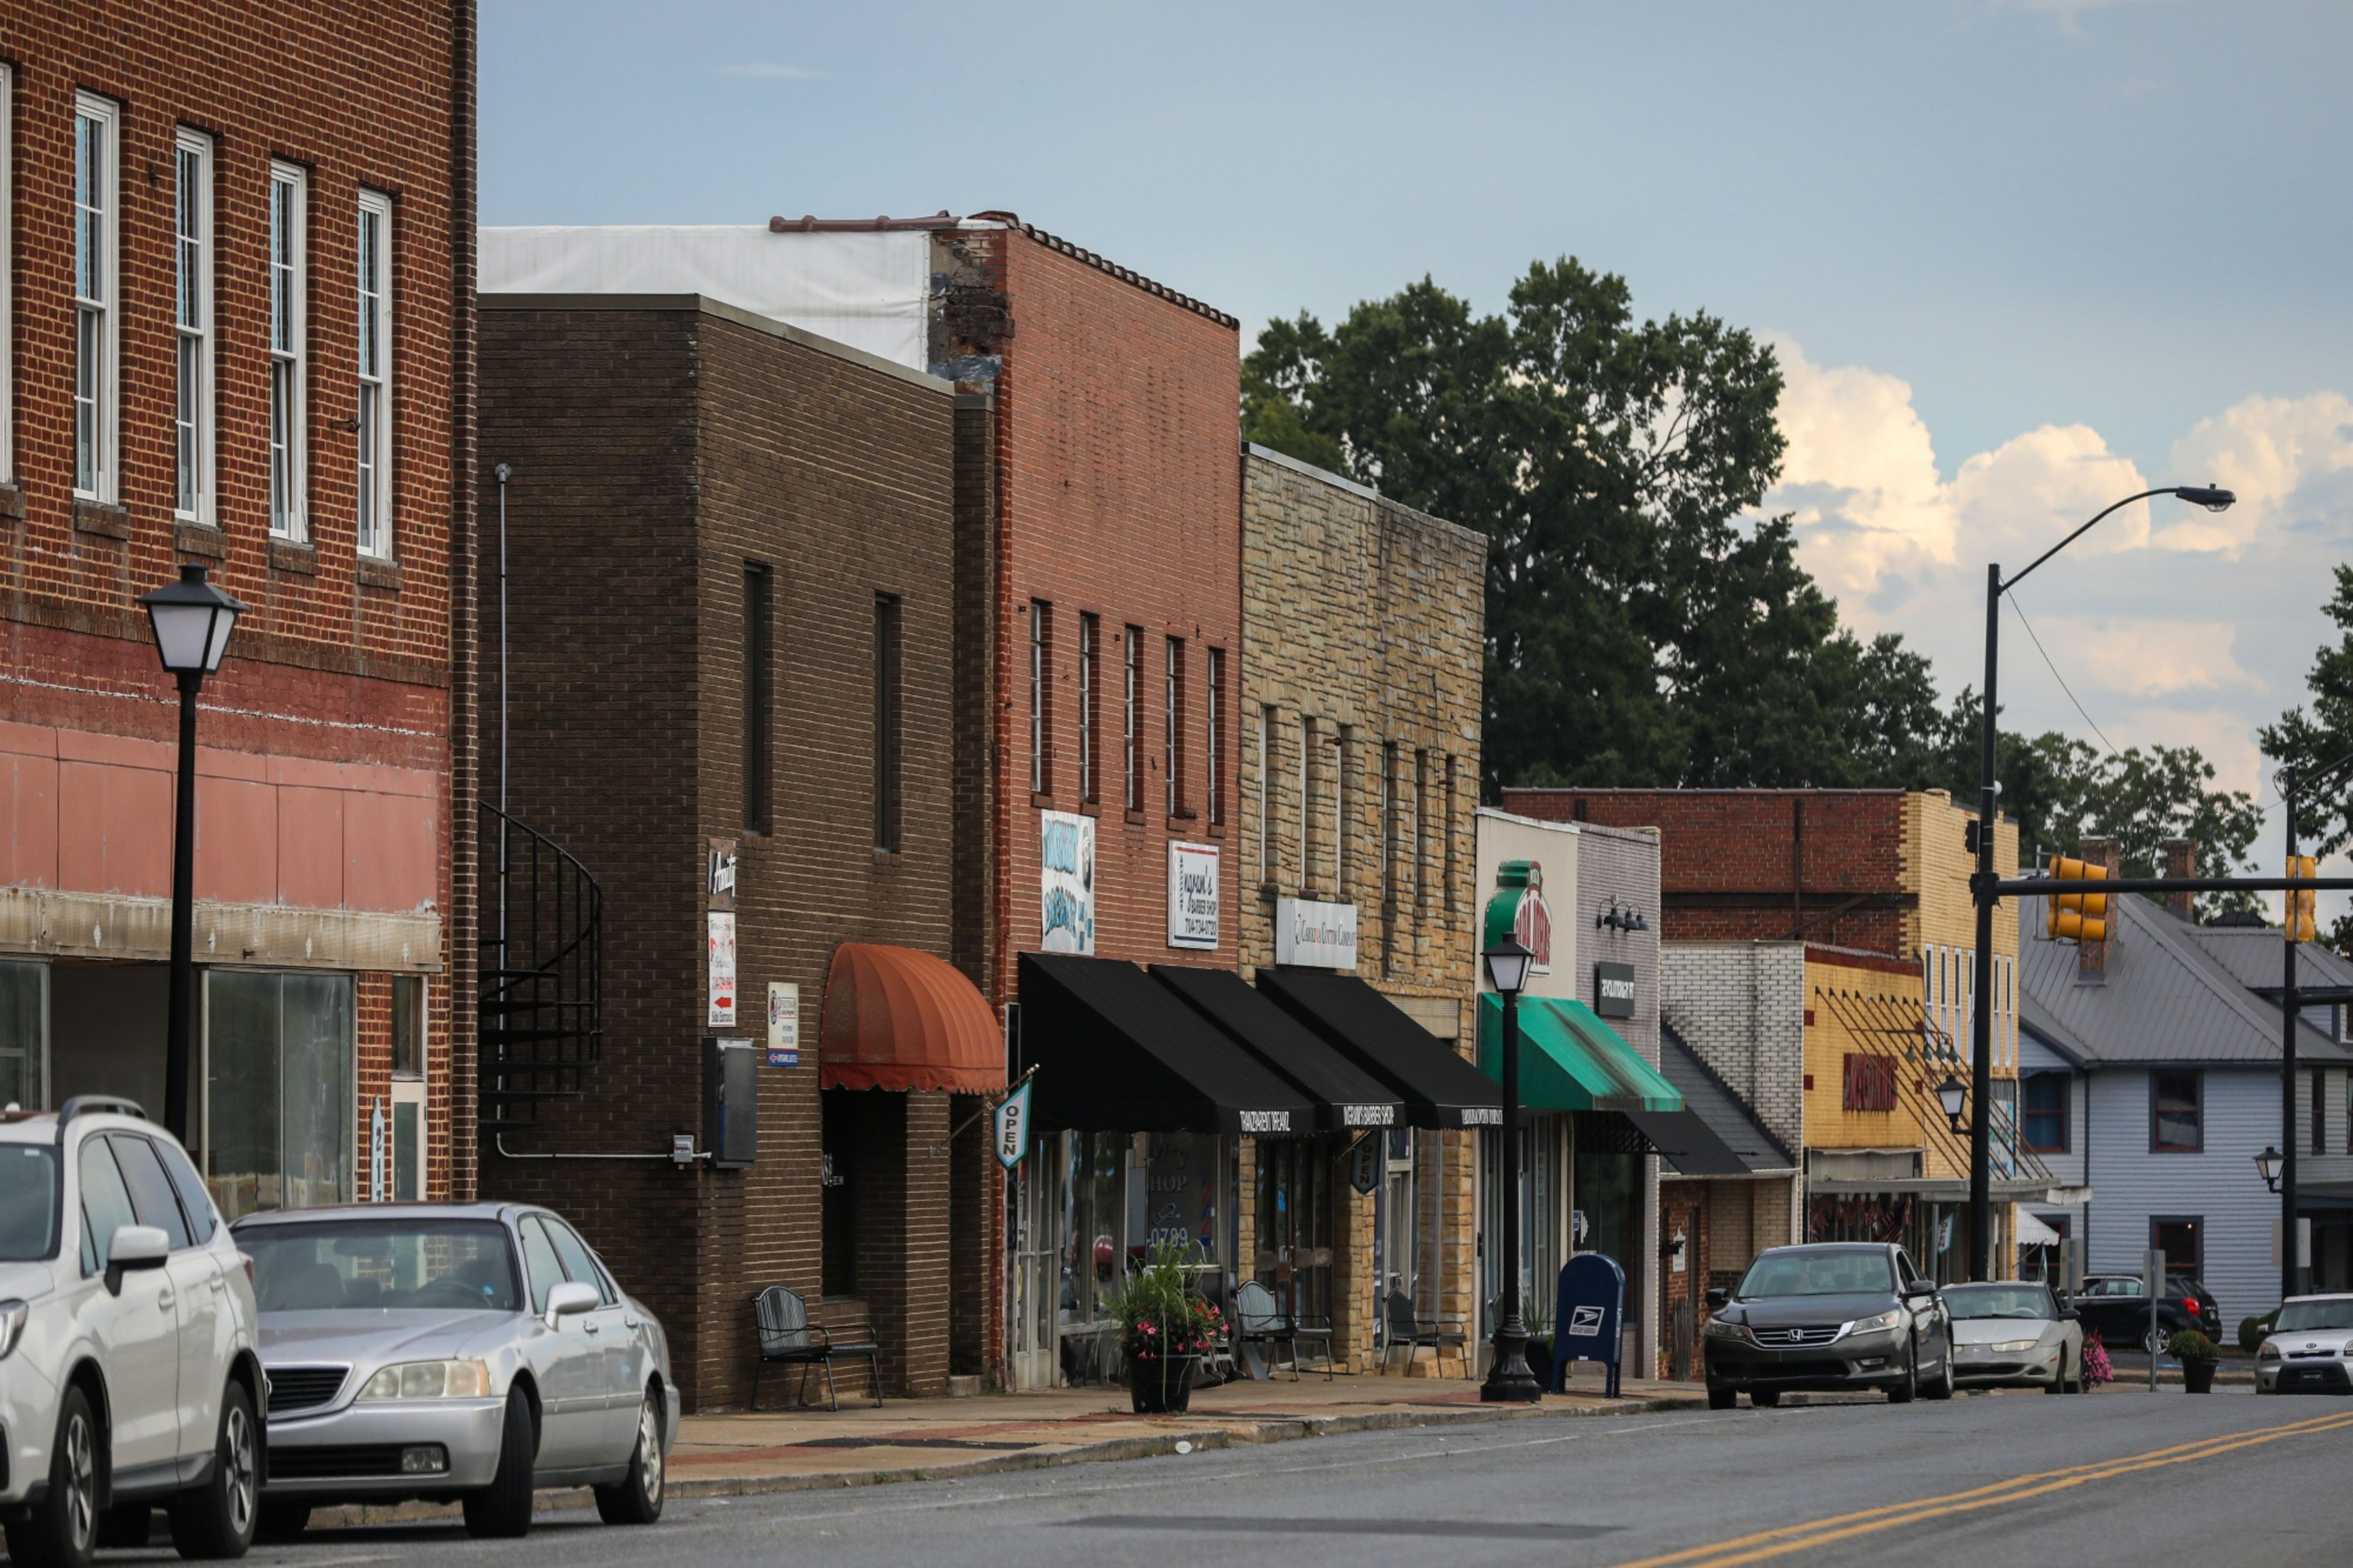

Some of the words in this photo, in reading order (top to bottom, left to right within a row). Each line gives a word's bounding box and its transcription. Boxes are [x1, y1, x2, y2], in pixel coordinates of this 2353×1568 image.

[1191, 899, 1207, 914] BARBER
[1207, 900, 1217, 915] SHOP
[1003, 1106, 1019, 1155] OPEN
[1360, 1145, 1372, 1185] OPEN
[1938, 1223, 1948, 1247] OPEN
